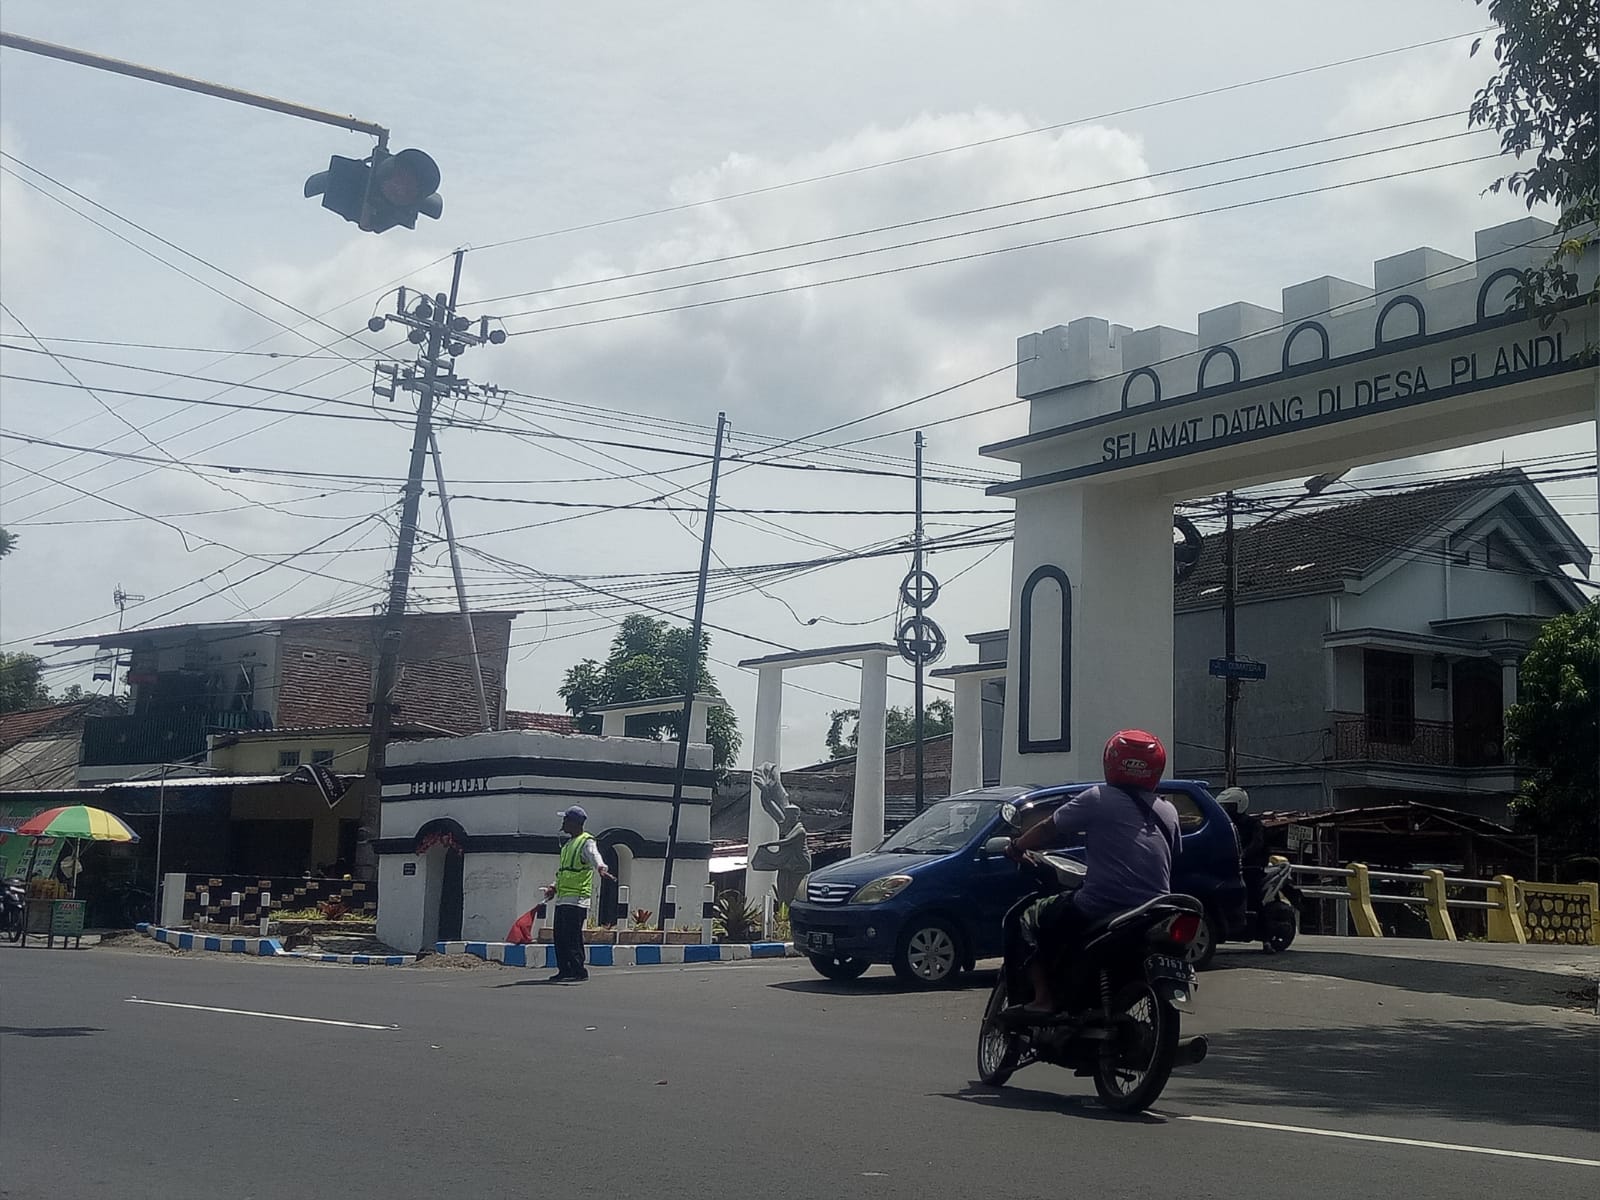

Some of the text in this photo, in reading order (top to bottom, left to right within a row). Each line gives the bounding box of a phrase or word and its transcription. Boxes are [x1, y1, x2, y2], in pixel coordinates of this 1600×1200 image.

[1102, 331, 1563, 462] SELAMAT DATANG DI DESA PLANDI
